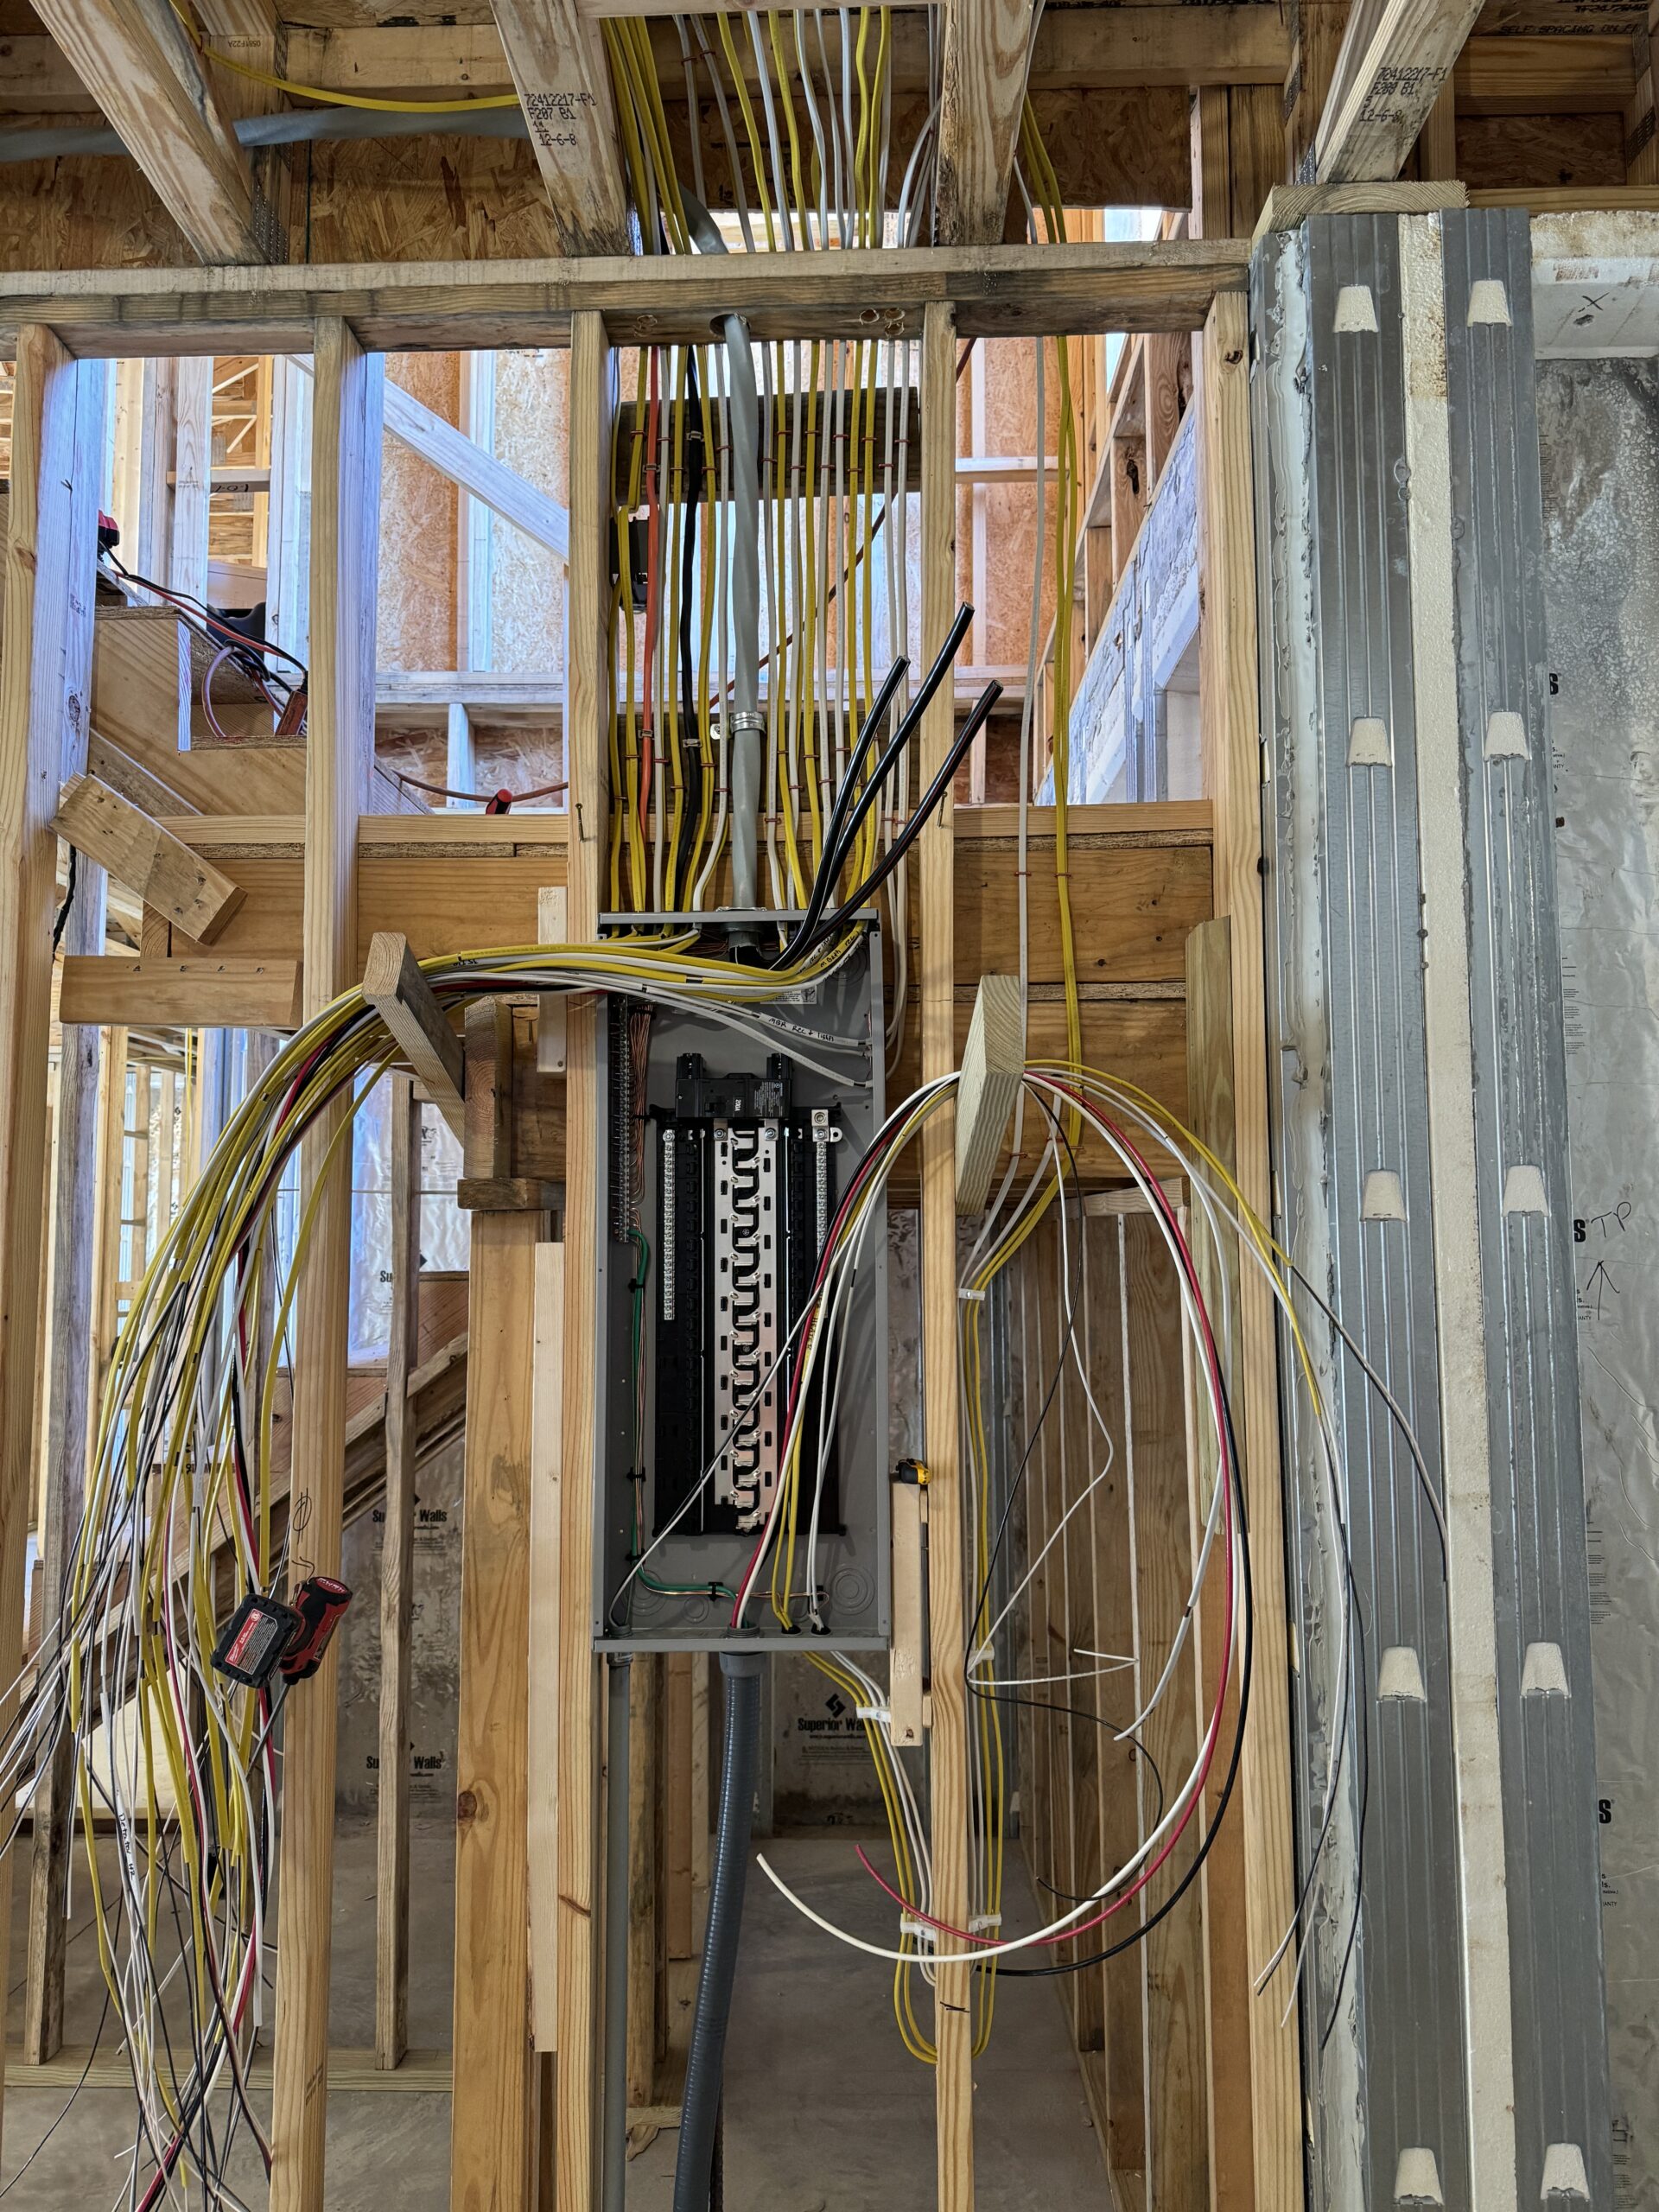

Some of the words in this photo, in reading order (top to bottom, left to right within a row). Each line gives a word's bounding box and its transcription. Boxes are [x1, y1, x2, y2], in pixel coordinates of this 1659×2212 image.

[524, 92, 598, 106] 72412217-F1
[558, 107, 577, 119] B1
[538, 133, 577, 146] 12-6-8
[419, 1509, 448, 1522] Walls
[798, 1718, 842, 1732] Superior
[413, 1755, 443, 1770] Walls
